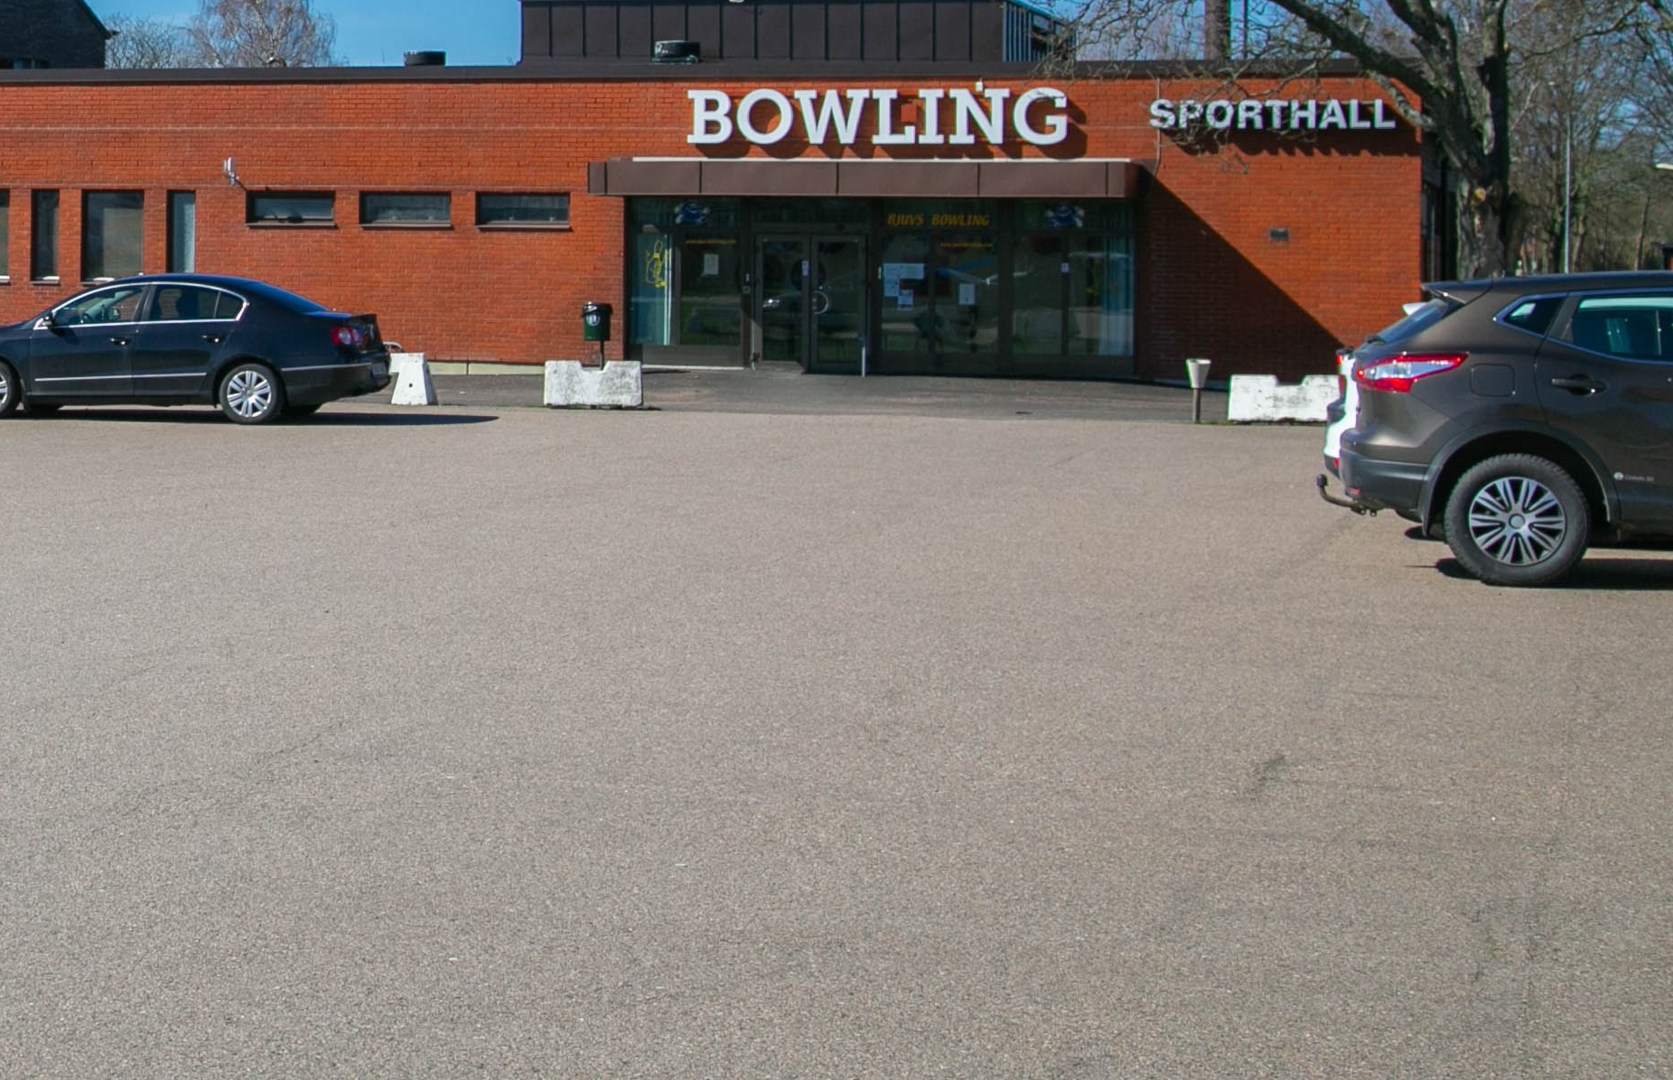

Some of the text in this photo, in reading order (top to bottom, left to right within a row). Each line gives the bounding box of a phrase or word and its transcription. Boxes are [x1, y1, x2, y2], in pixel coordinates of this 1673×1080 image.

[686, 87, 1068, 146] BOWLING
[1149, 98, 1396, 130] SPORTHALL
[930, 213, 990, 228] BOWLING
